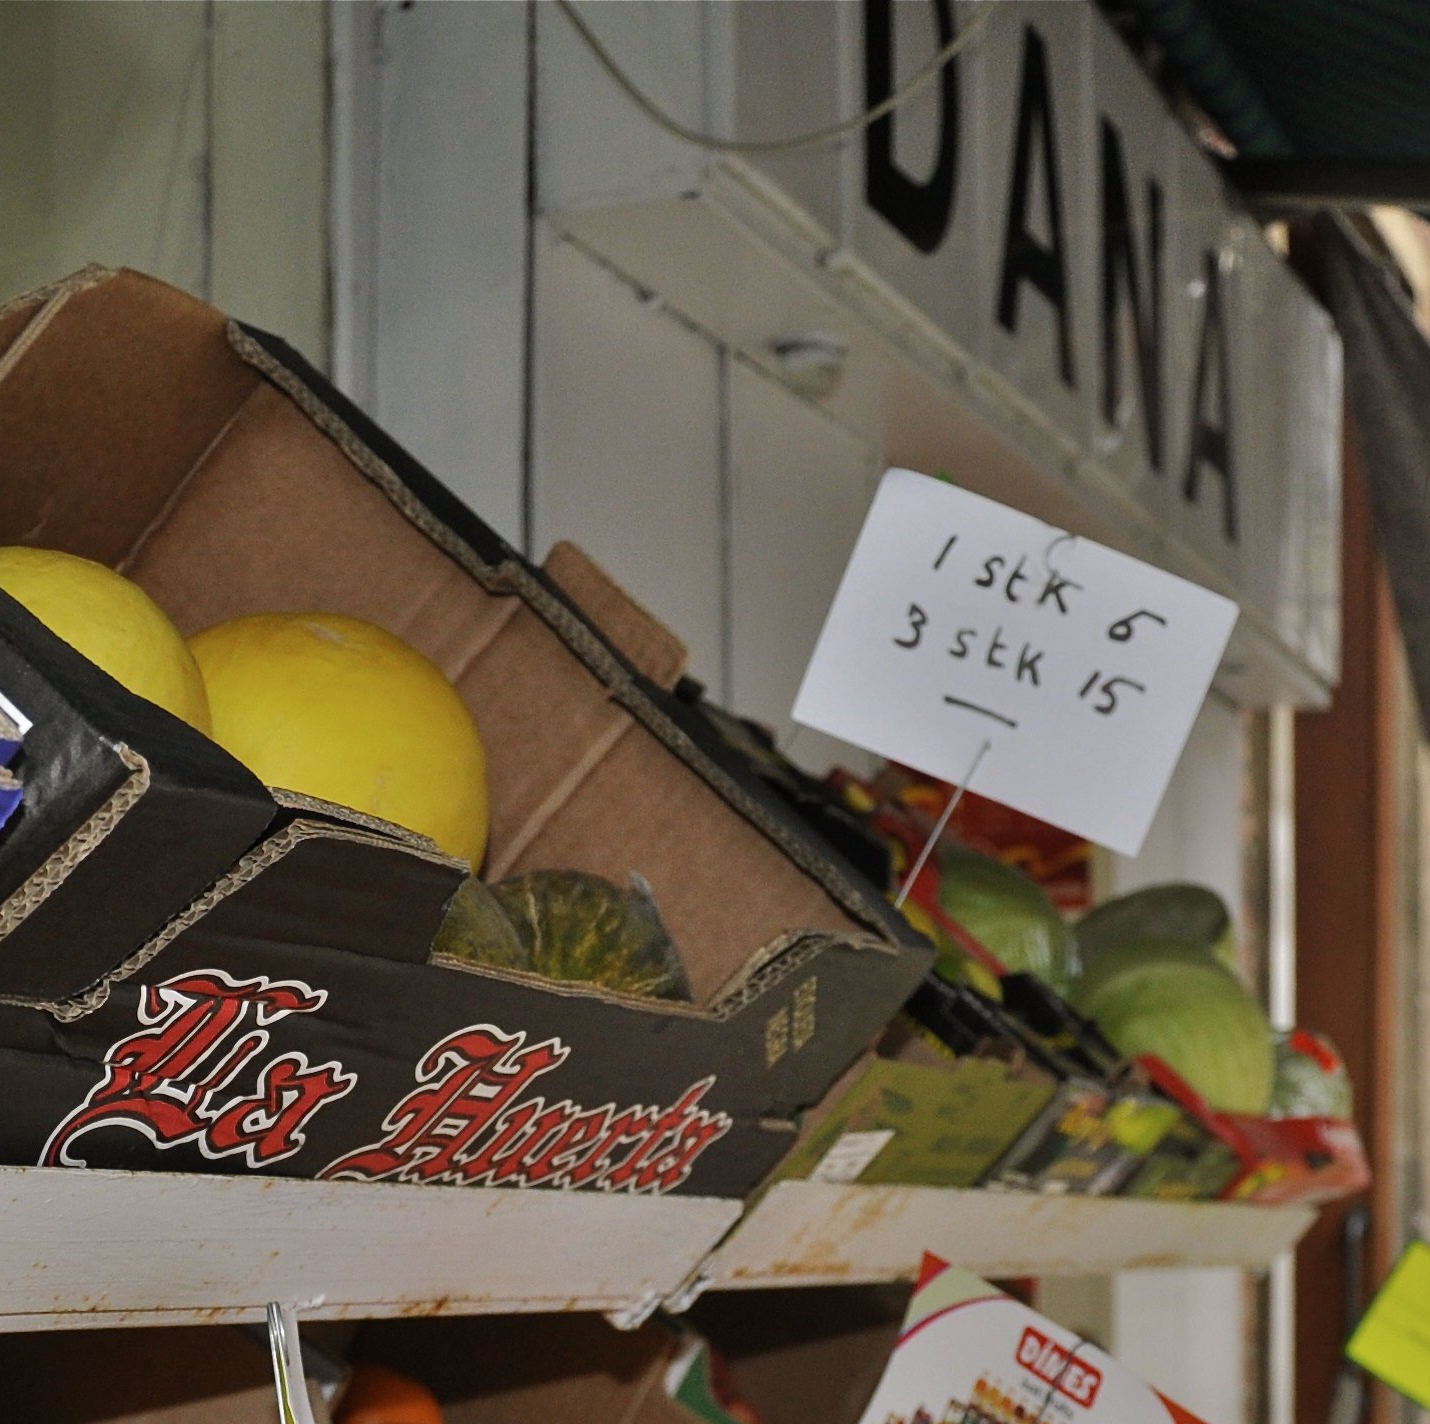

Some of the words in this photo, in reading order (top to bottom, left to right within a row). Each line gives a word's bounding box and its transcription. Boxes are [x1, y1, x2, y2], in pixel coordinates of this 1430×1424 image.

[933, 535, 959, 570] 1
[1107, 608, 1168, 642] 6
[893, 604, 928, 649] 3
[1079, 671, 1146, 715] 15
[37, 967, 358, 1169] La
[315, 1022, 733, 1196] Huerta
